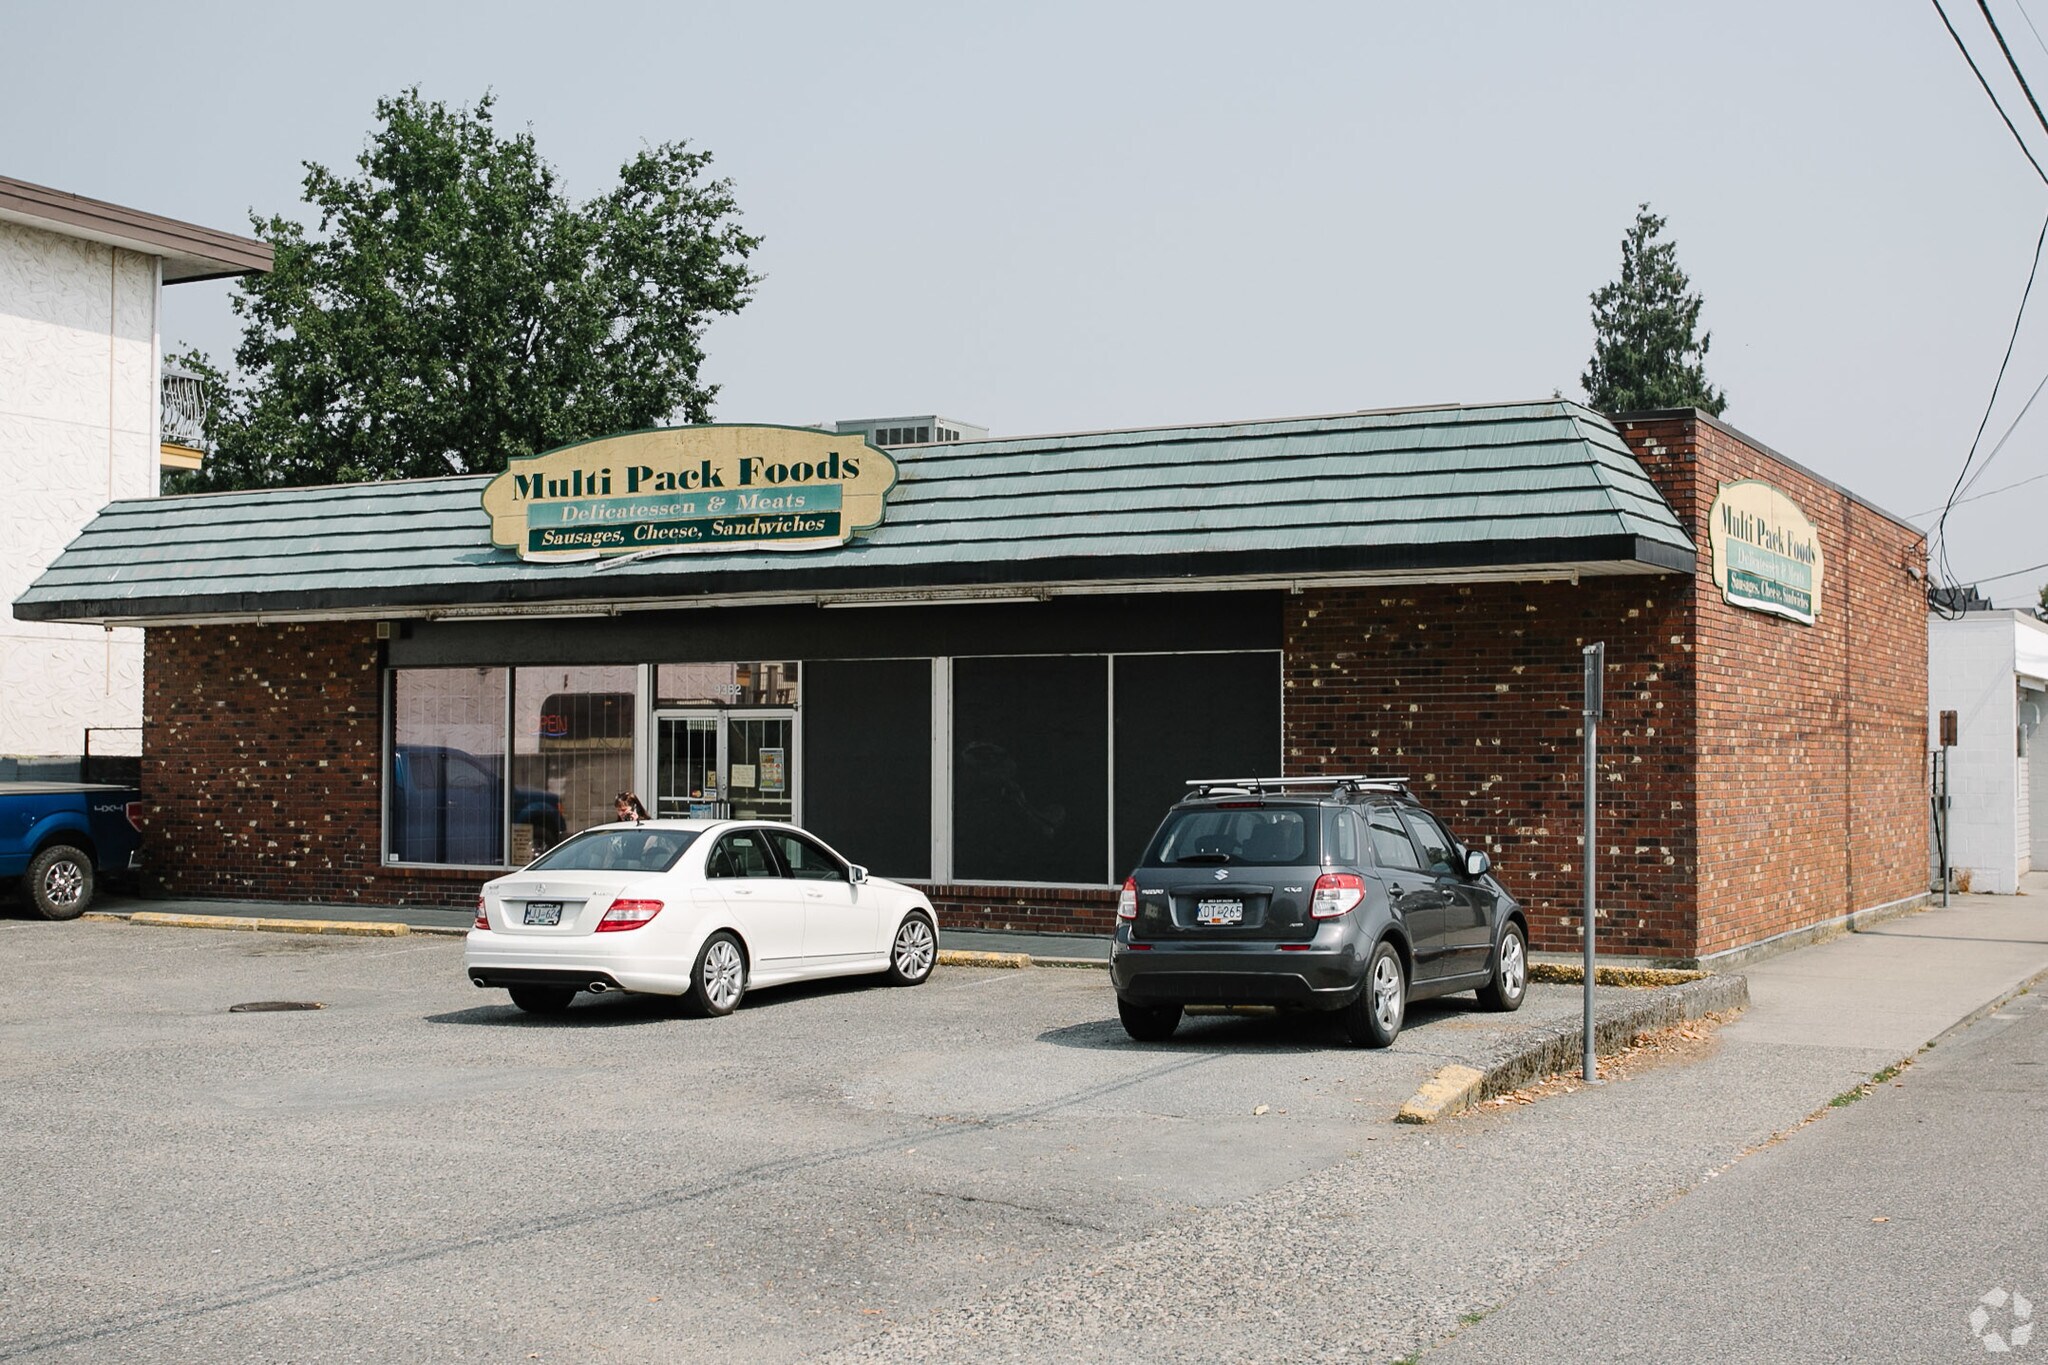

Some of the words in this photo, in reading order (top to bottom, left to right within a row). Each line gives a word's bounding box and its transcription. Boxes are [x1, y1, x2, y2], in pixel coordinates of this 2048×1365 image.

[513, 467, 612, 502] Multi
[626, 460, 725, 494] Pack
[739, 452, 861, 486] Foods
[561, 500, 695, 523] Delicatessen
[707, 496, 727, 512] &
[737, 493, 805, 512] Meats
[541, 528, 625, 547] Sausages,
[634, 523, 703, 541] Cheese,
[711, 516, 825, 536] Sandwiches
[1721, 502, 1753, 543] Multi
[1757, 517, 1785, 555] Pack
[1787, 529, 1816, 566] Foods
[714, 684, 742, 696] 9382
[527, 714, 568, 732] OPEN
